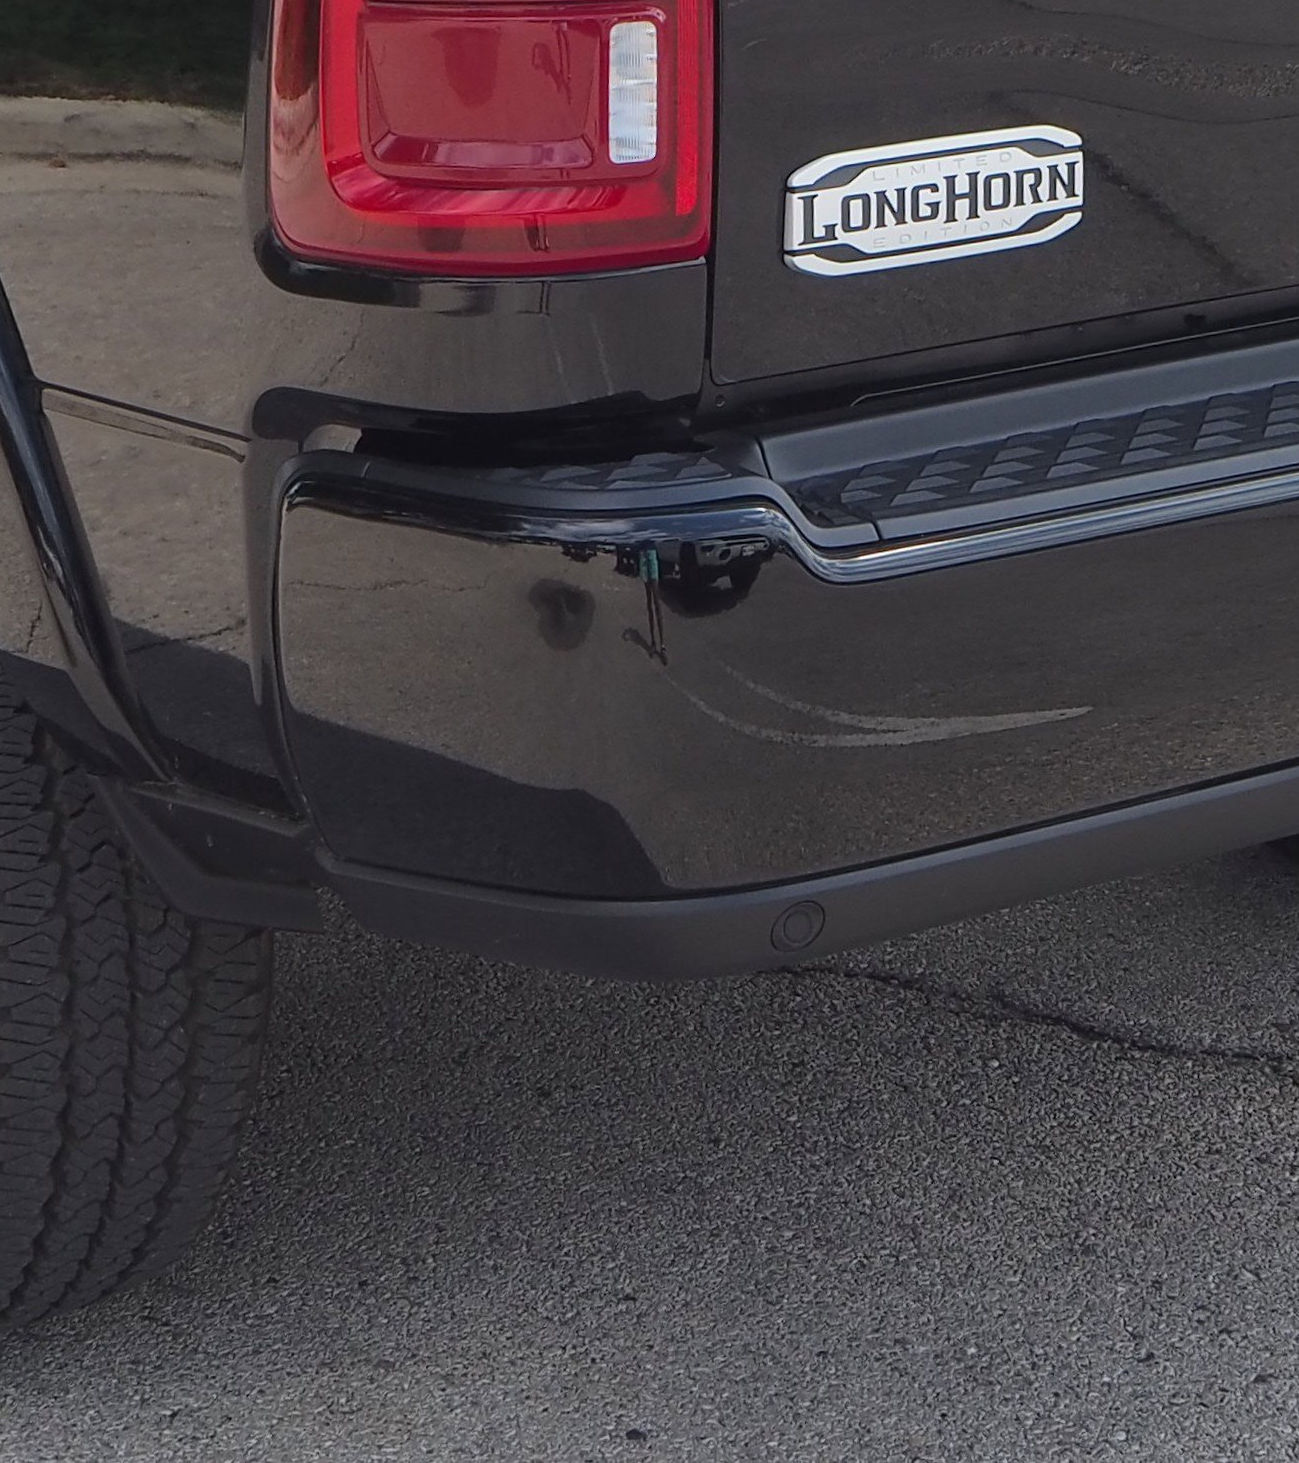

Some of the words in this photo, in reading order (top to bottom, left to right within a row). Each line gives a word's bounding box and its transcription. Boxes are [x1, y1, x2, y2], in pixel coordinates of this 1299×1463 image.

[871, 151, 1013, 182] LIMITED
[796, 160, 1081, 247] LONGHORN
[872, 217, 1014, 249] EDITION
